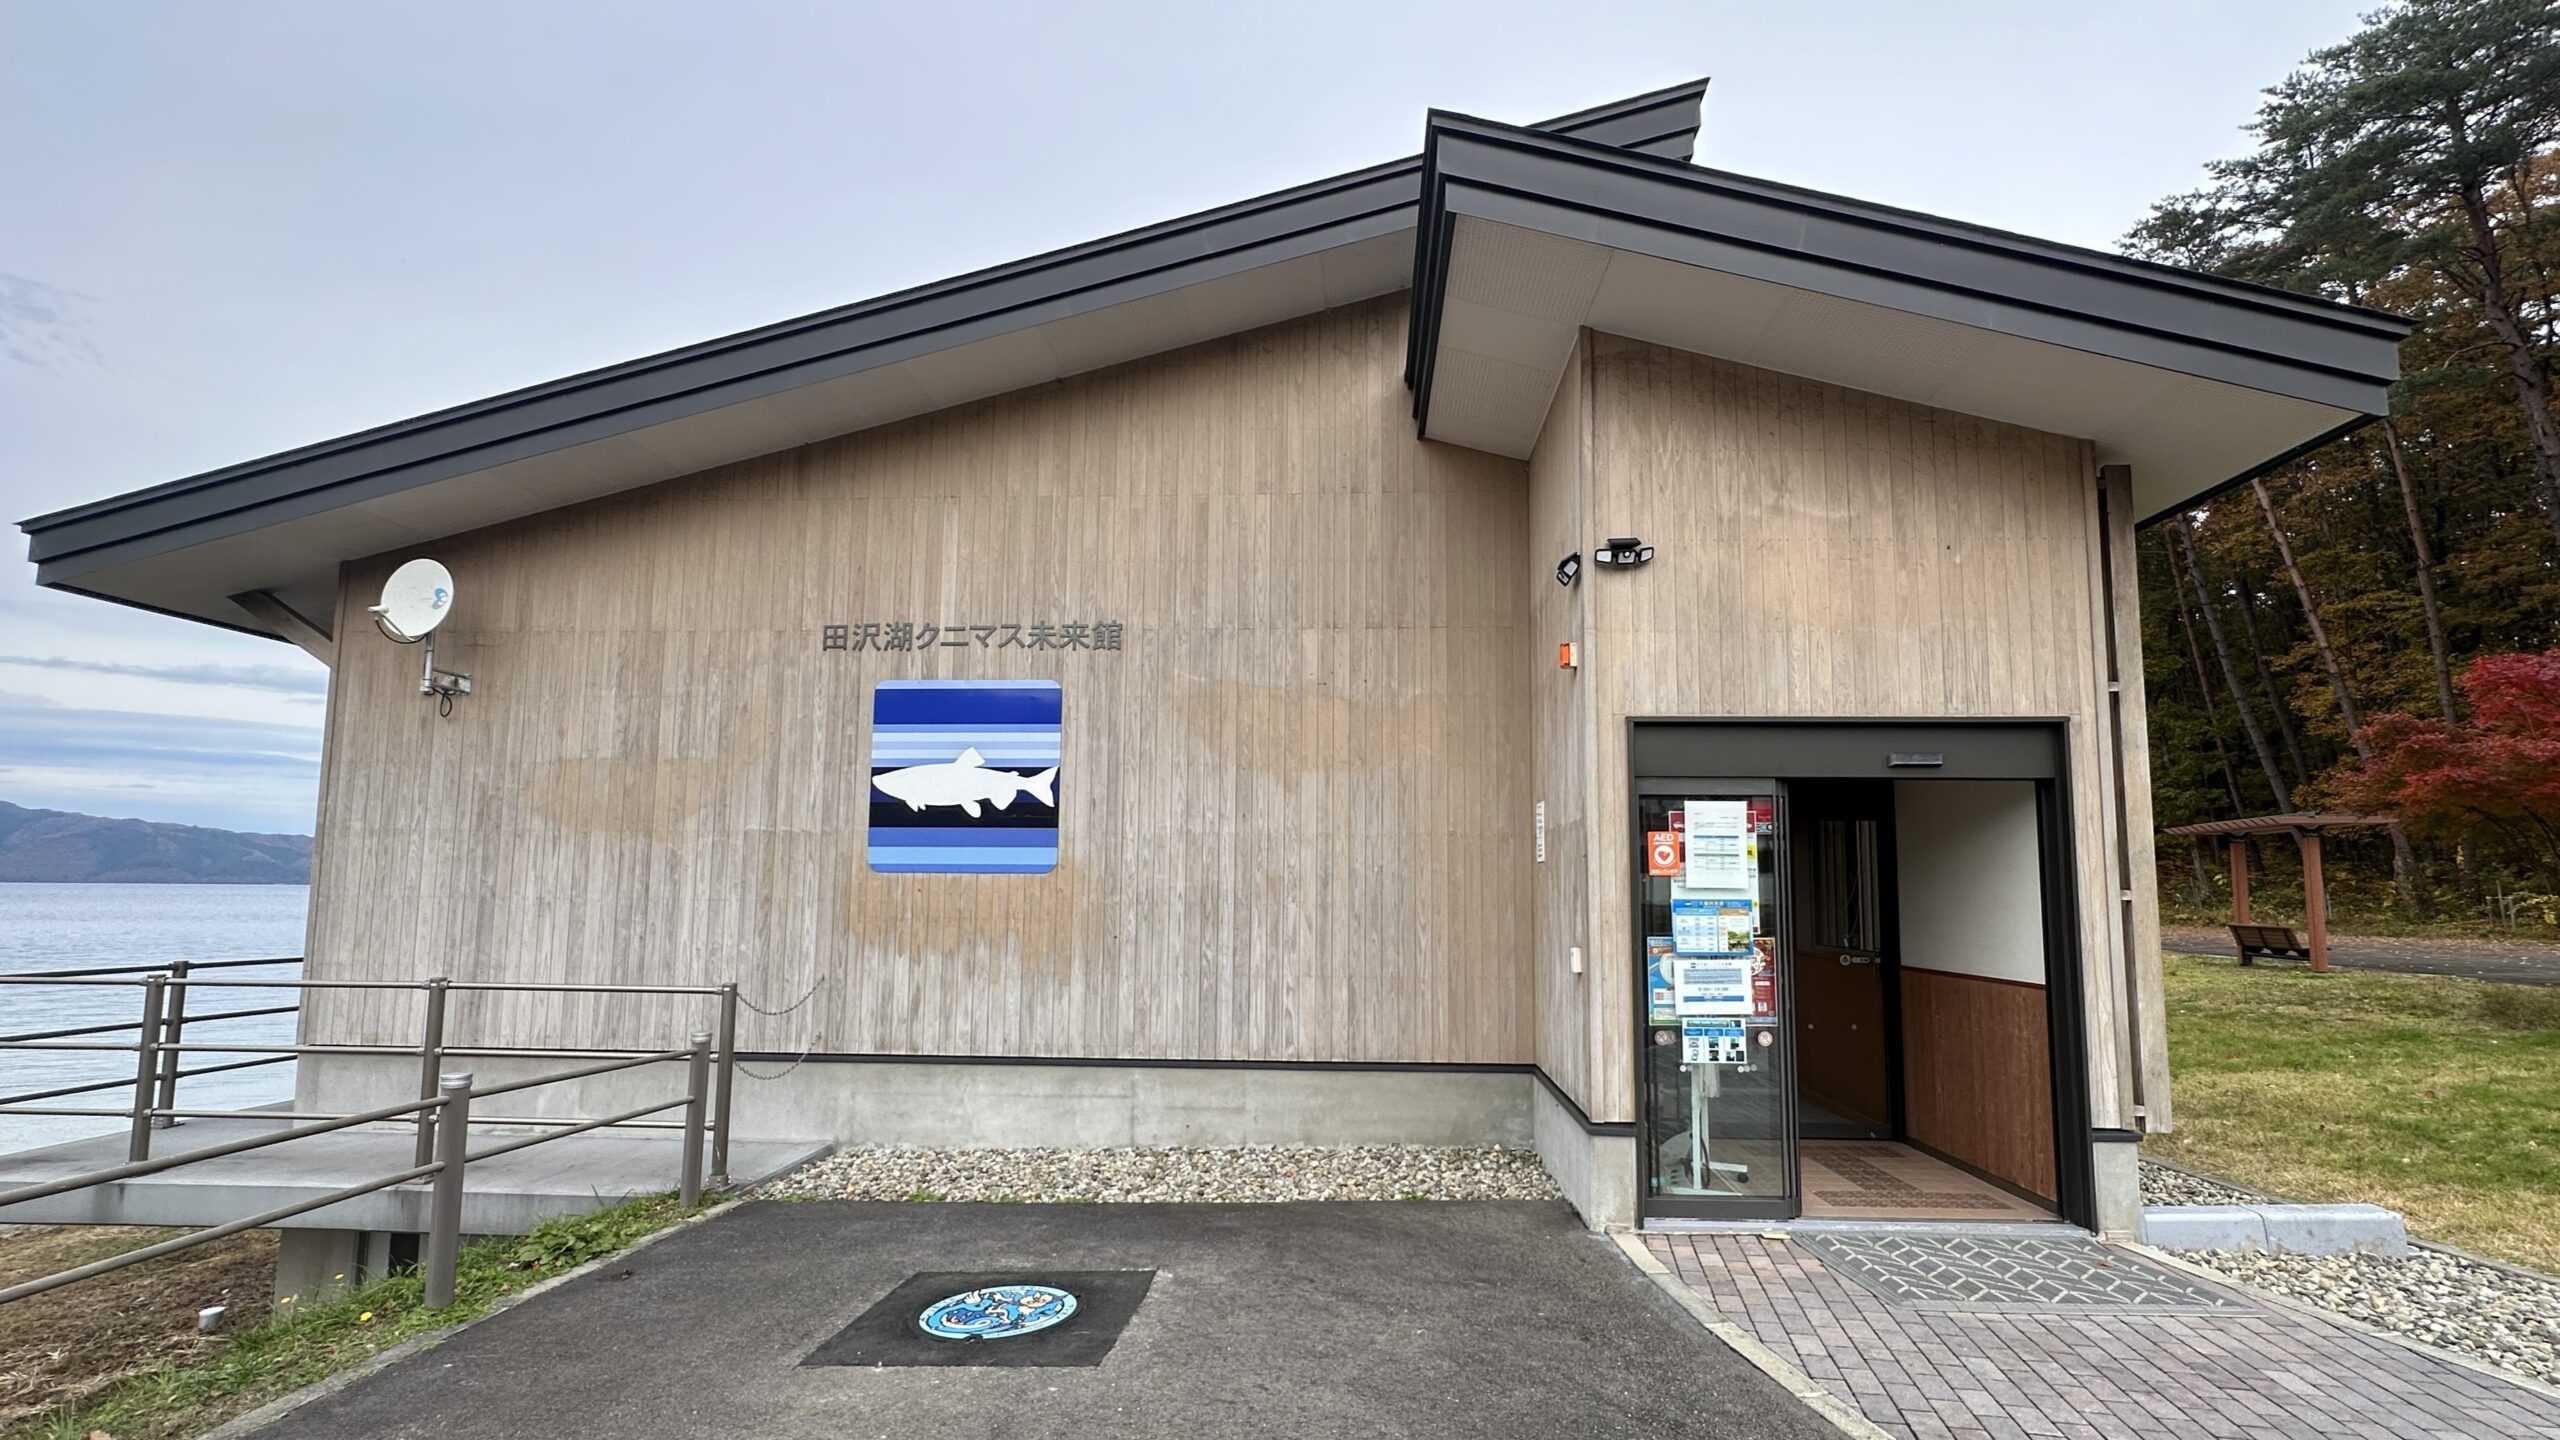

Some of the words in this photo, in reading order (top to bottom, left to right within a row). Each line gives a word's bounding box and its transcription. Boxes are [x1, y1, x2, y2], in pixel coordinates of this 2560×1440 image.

[822, 620, 1123, 651] 田沢湖クニマス未来館
[1653, 833, 1674, 842] AED
